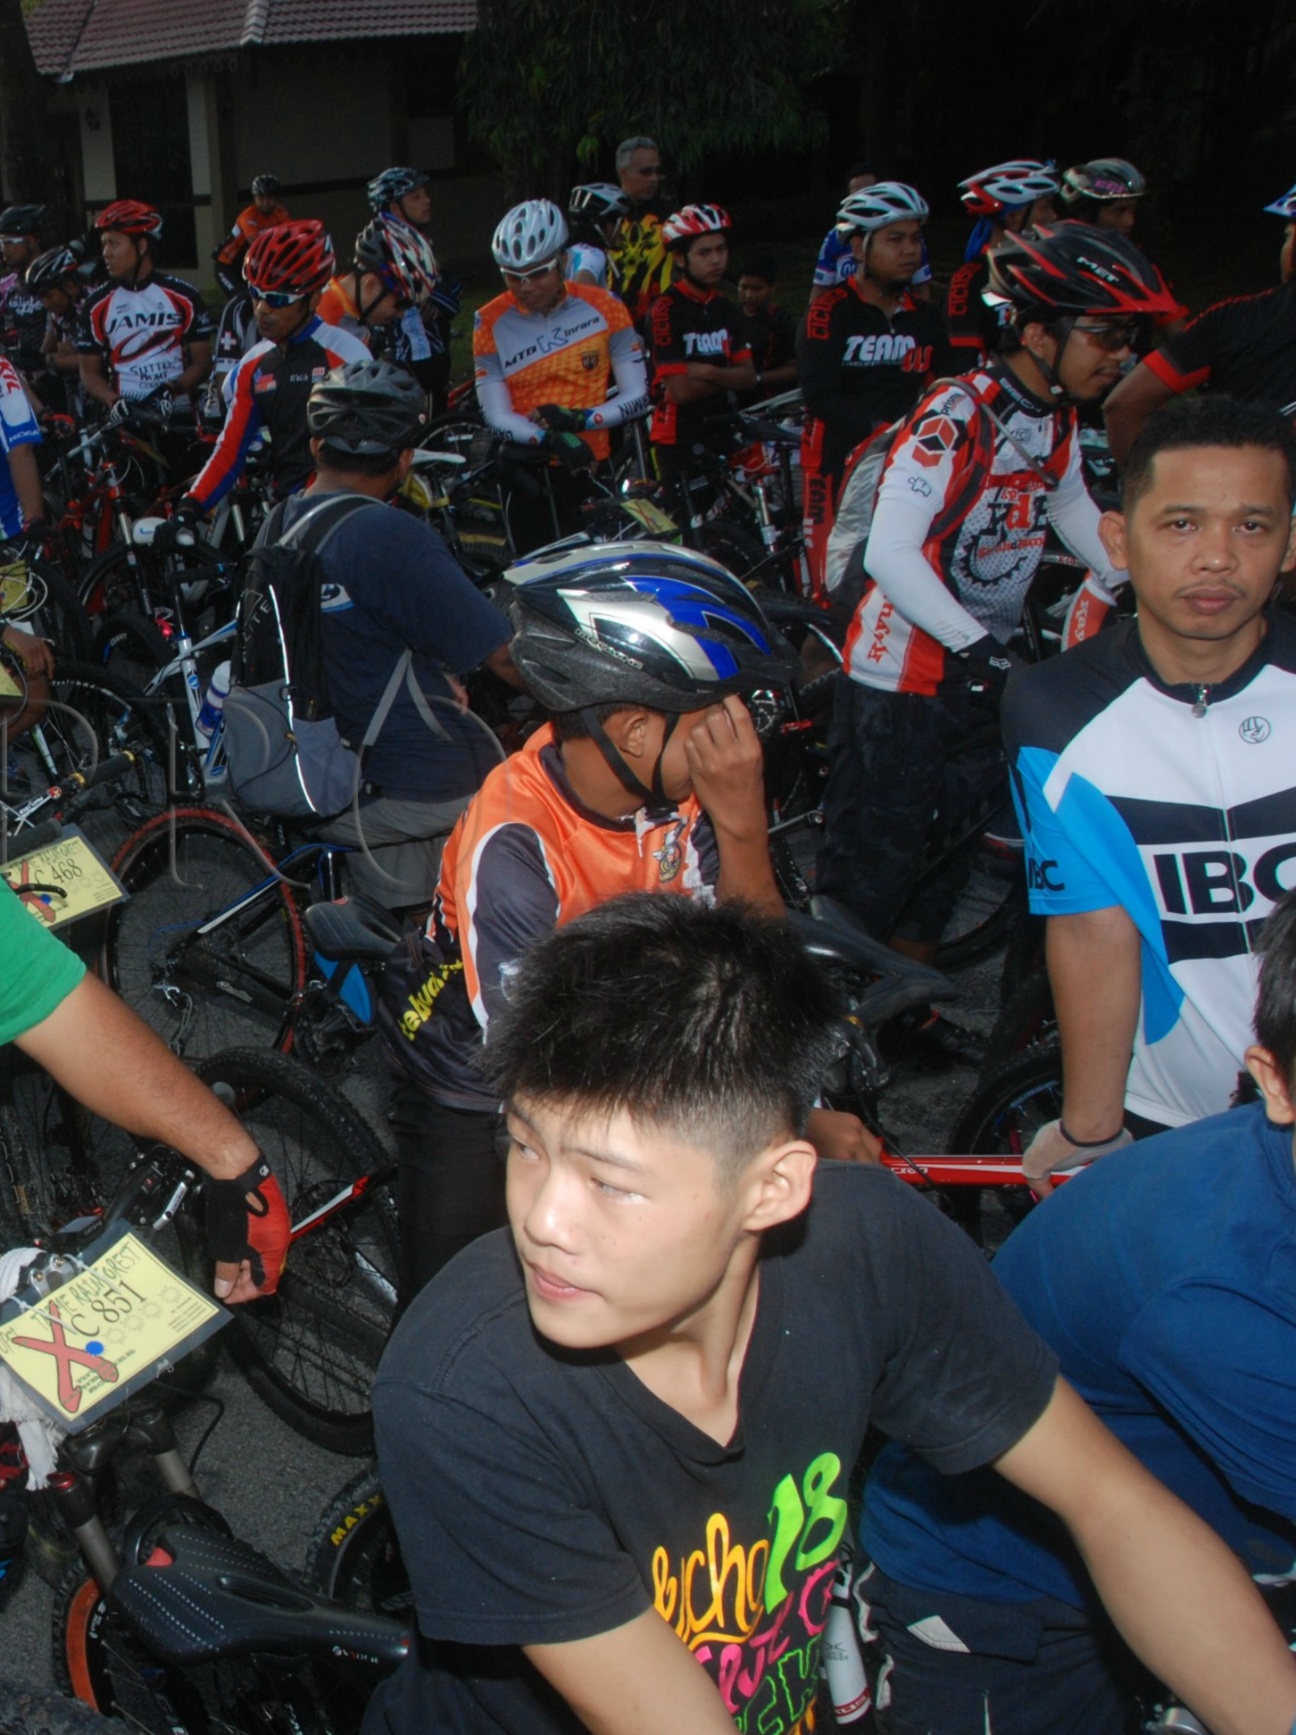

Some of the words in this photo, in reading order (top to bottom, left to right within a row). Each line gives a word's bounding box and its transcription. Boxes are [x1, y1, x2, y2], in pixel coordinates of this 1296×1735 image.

[1076, 256, 1119, 283] MET
[107, 312, 183, 334] JAMIS
[505, 346, 537, 369] MTB
[842, 334, 916, 362] TEAM
[50, 857, 83, 884] 468
[1027, 858, 1066, 892] IBC
[1153, 842, 1296, 915] IBC
[70, 1312, 101, 1338] C
[90, 1279, 147, 1325] 851
[764, 1452, 848, 1615] 18
